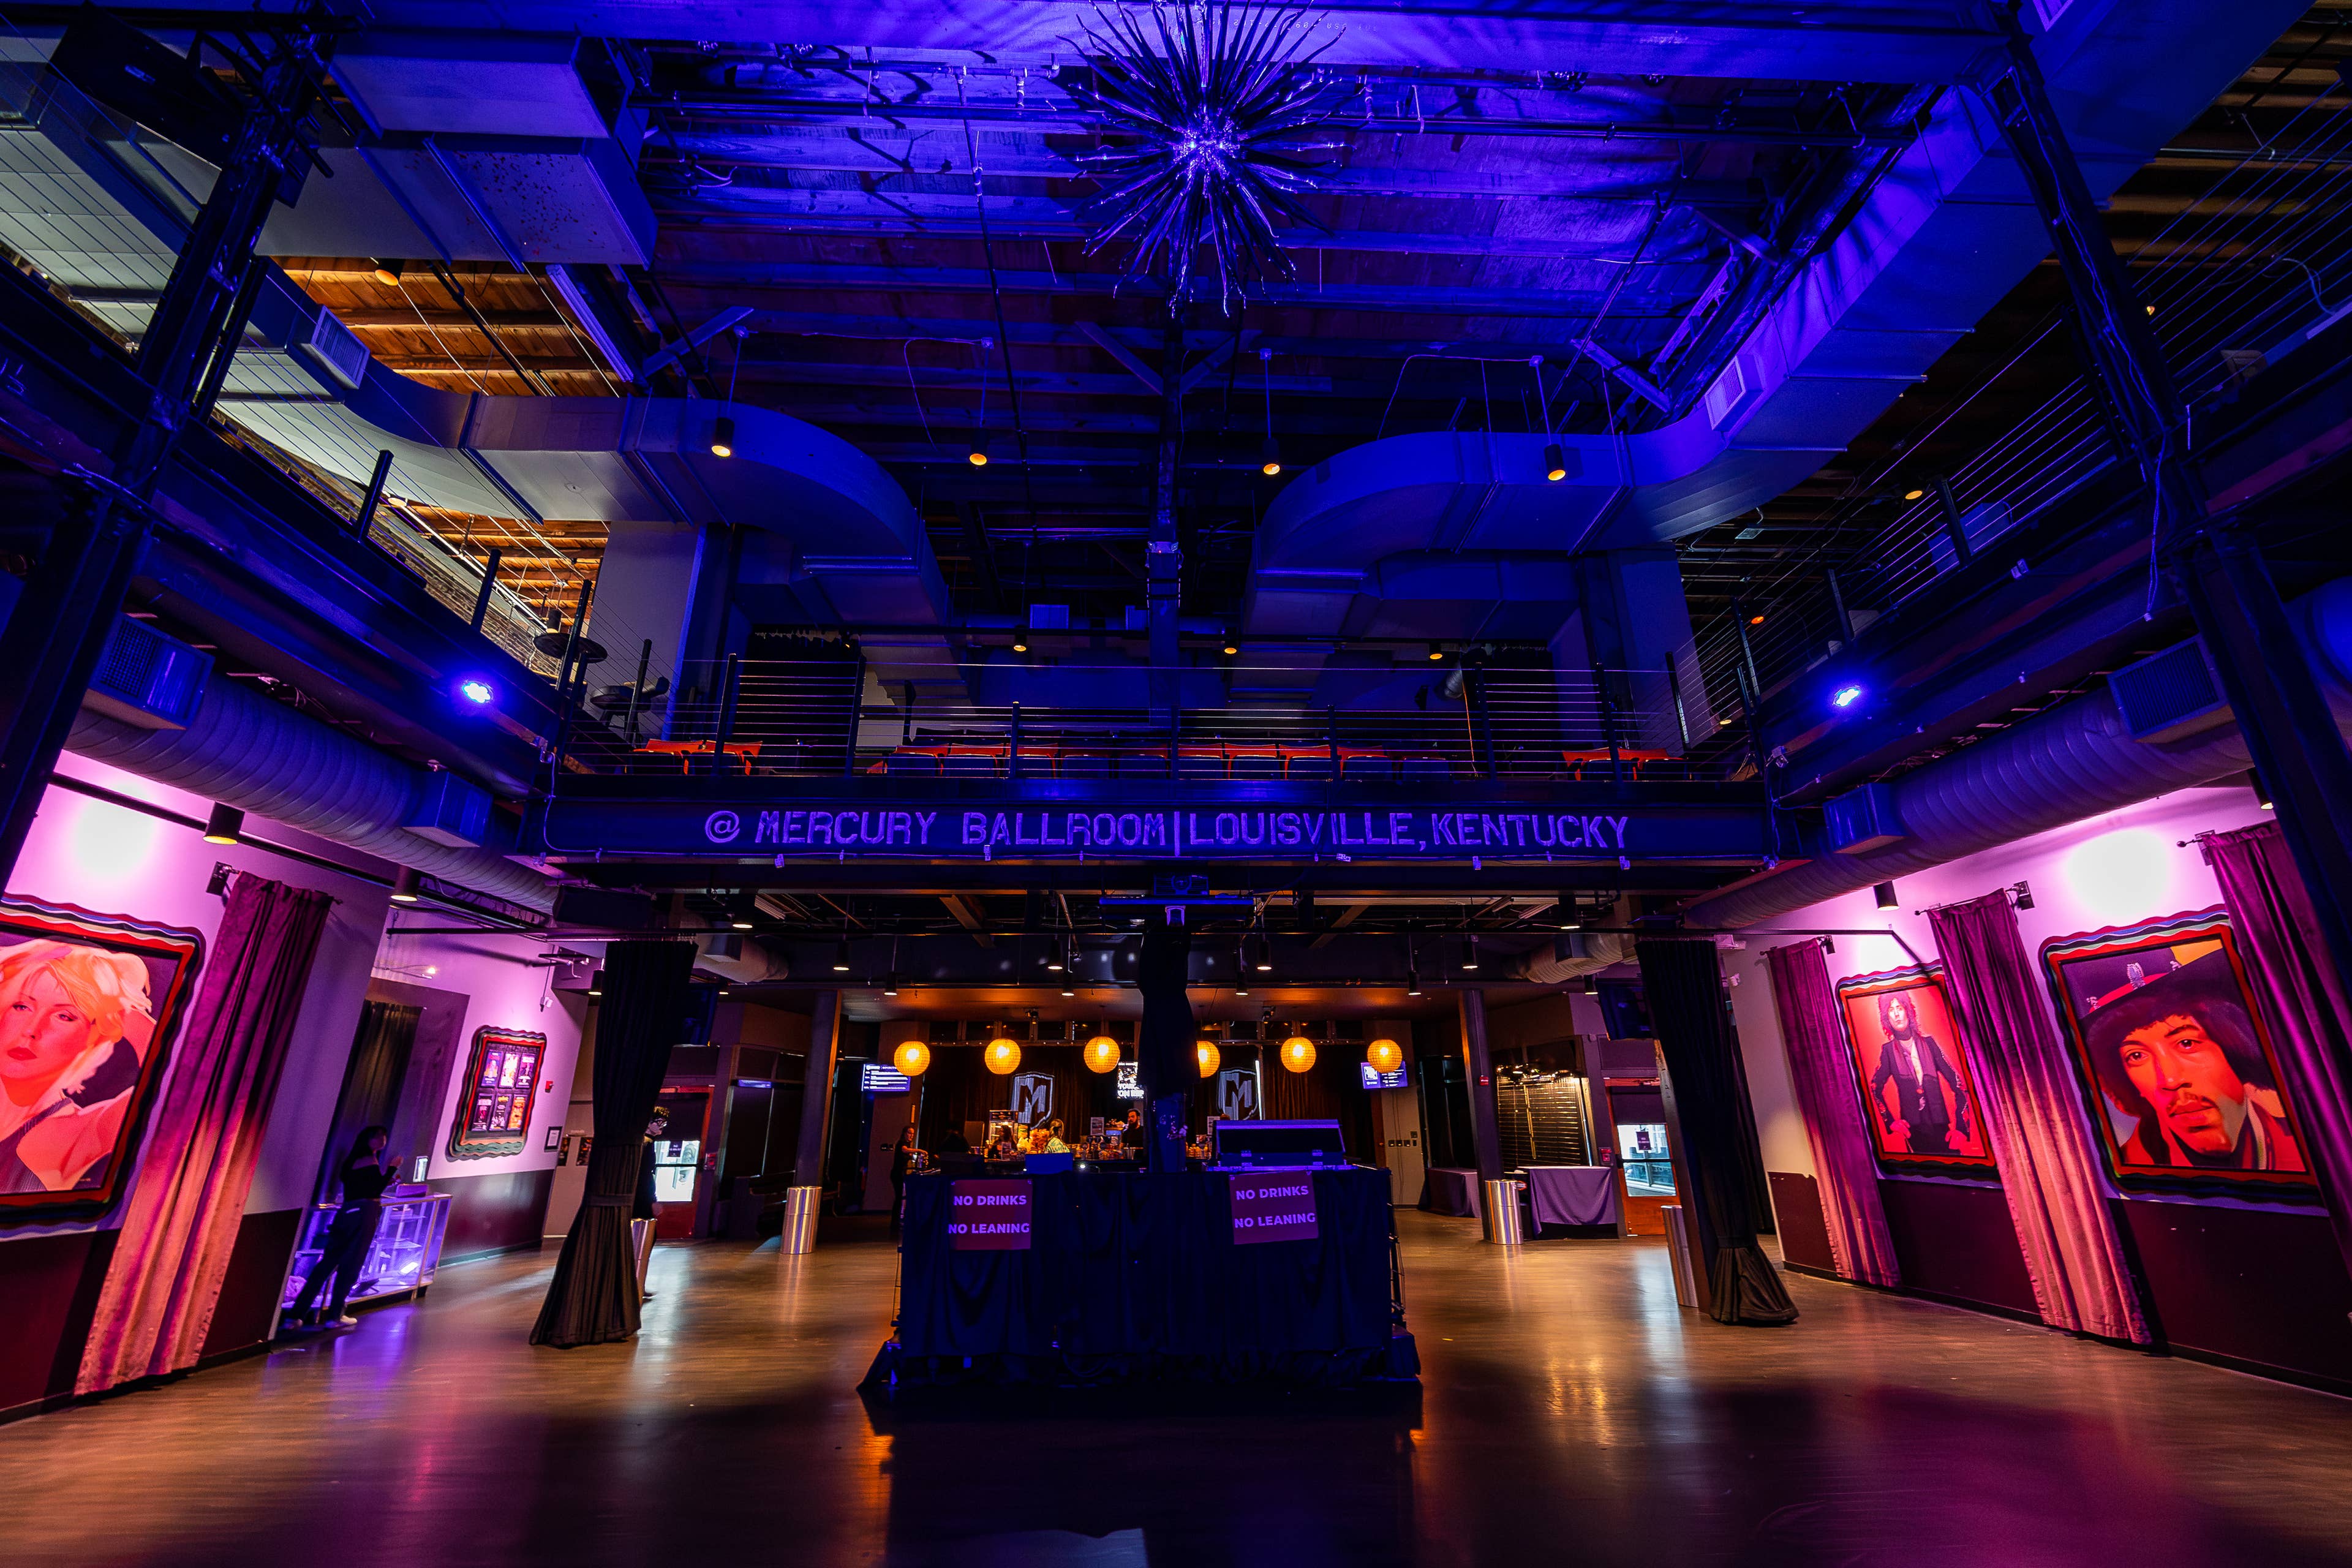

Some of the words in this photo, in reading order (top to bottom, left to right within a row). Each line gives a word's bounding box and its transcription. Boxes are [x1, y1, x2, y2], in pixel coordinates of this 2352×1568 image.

[704, 810, 739, 843] @
[755, 810, 937, 844] MERCURY
[962, 812, 1165, 845] BALLROOM
[1431, 813, 1629, 849] KENTUCKY
[954, 1195, 973, 1205] NO
[977, 1195, 1027, 1205] DRINKS
[1235, 1189, 1255, 1200] NO
[1259, 1185, 1309, 1198] DRINKS
[1234, 1217, 1254, 1228] NO
[1257, 1212, 1316, 1226] LEANING
[948, 1223, 967, 1234] NO
[971, 1223, 1030, 1233] LEANING
